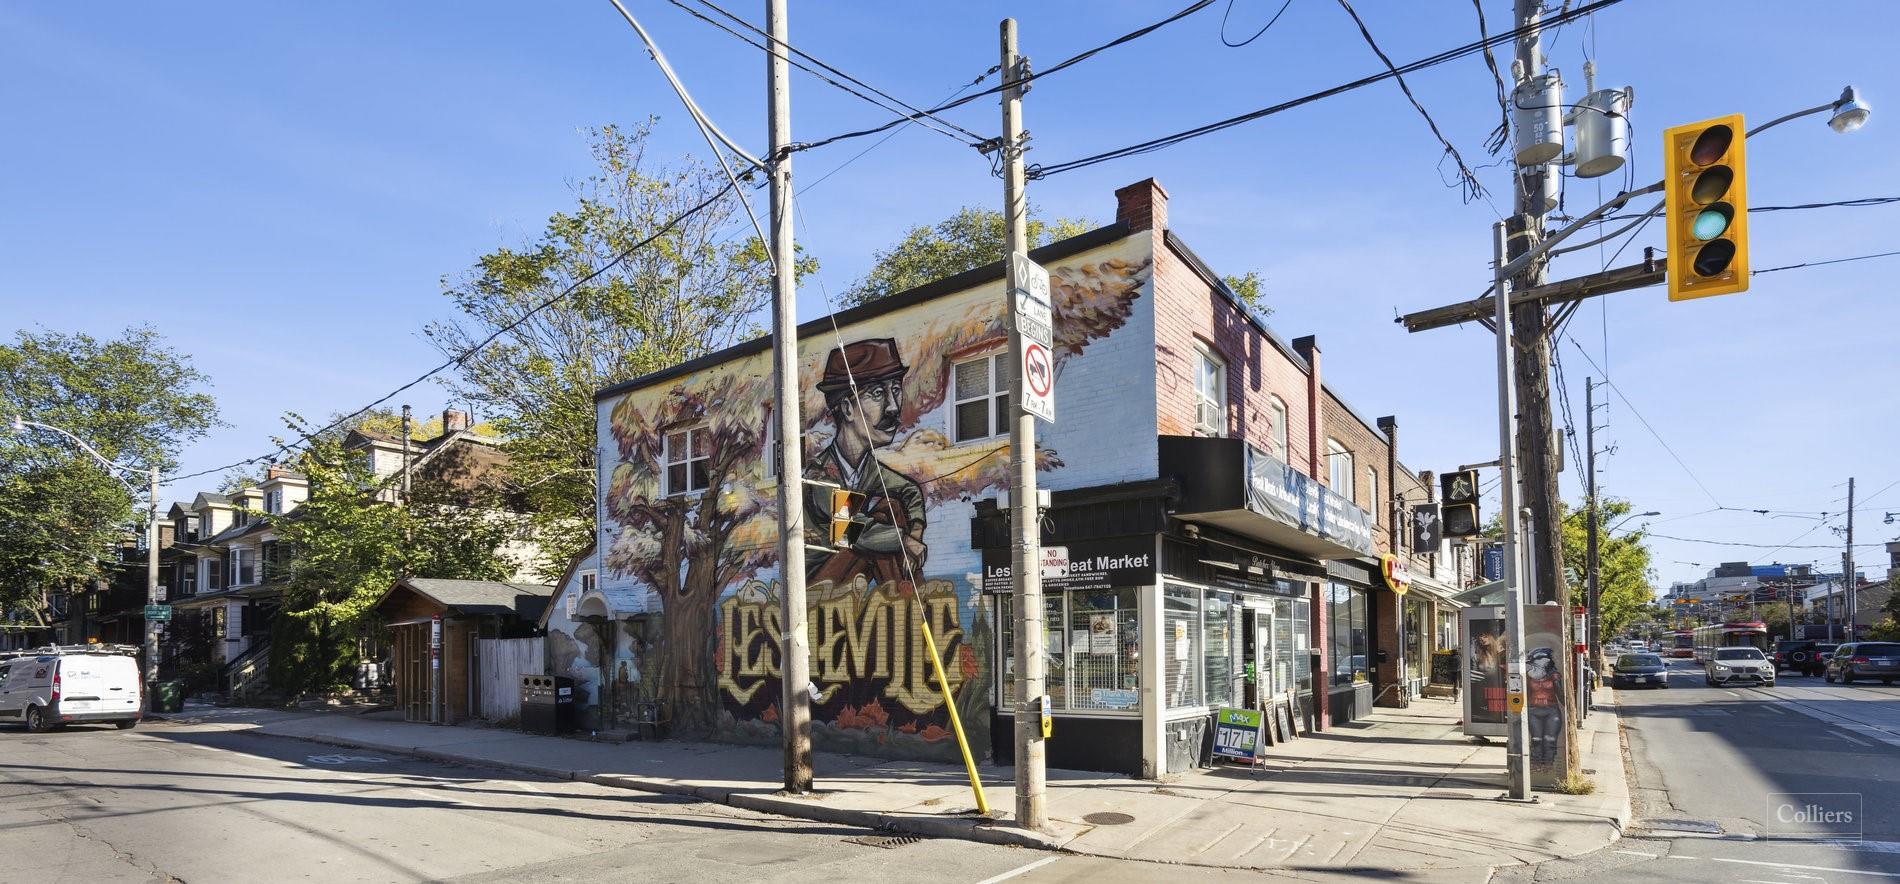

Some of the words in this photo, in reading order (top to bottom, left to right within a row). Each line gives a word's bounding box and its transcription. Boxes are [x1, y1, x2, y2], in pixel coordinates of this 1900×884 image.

[1020, 316, 1049, 344] BEGINS
[1047, 549, 1057, 557] NO
[1070, 558, 1093, 572] eat
[1096, 554, 1149, 570] Market
[717, 588, 965, 715] LESIEVILLE
